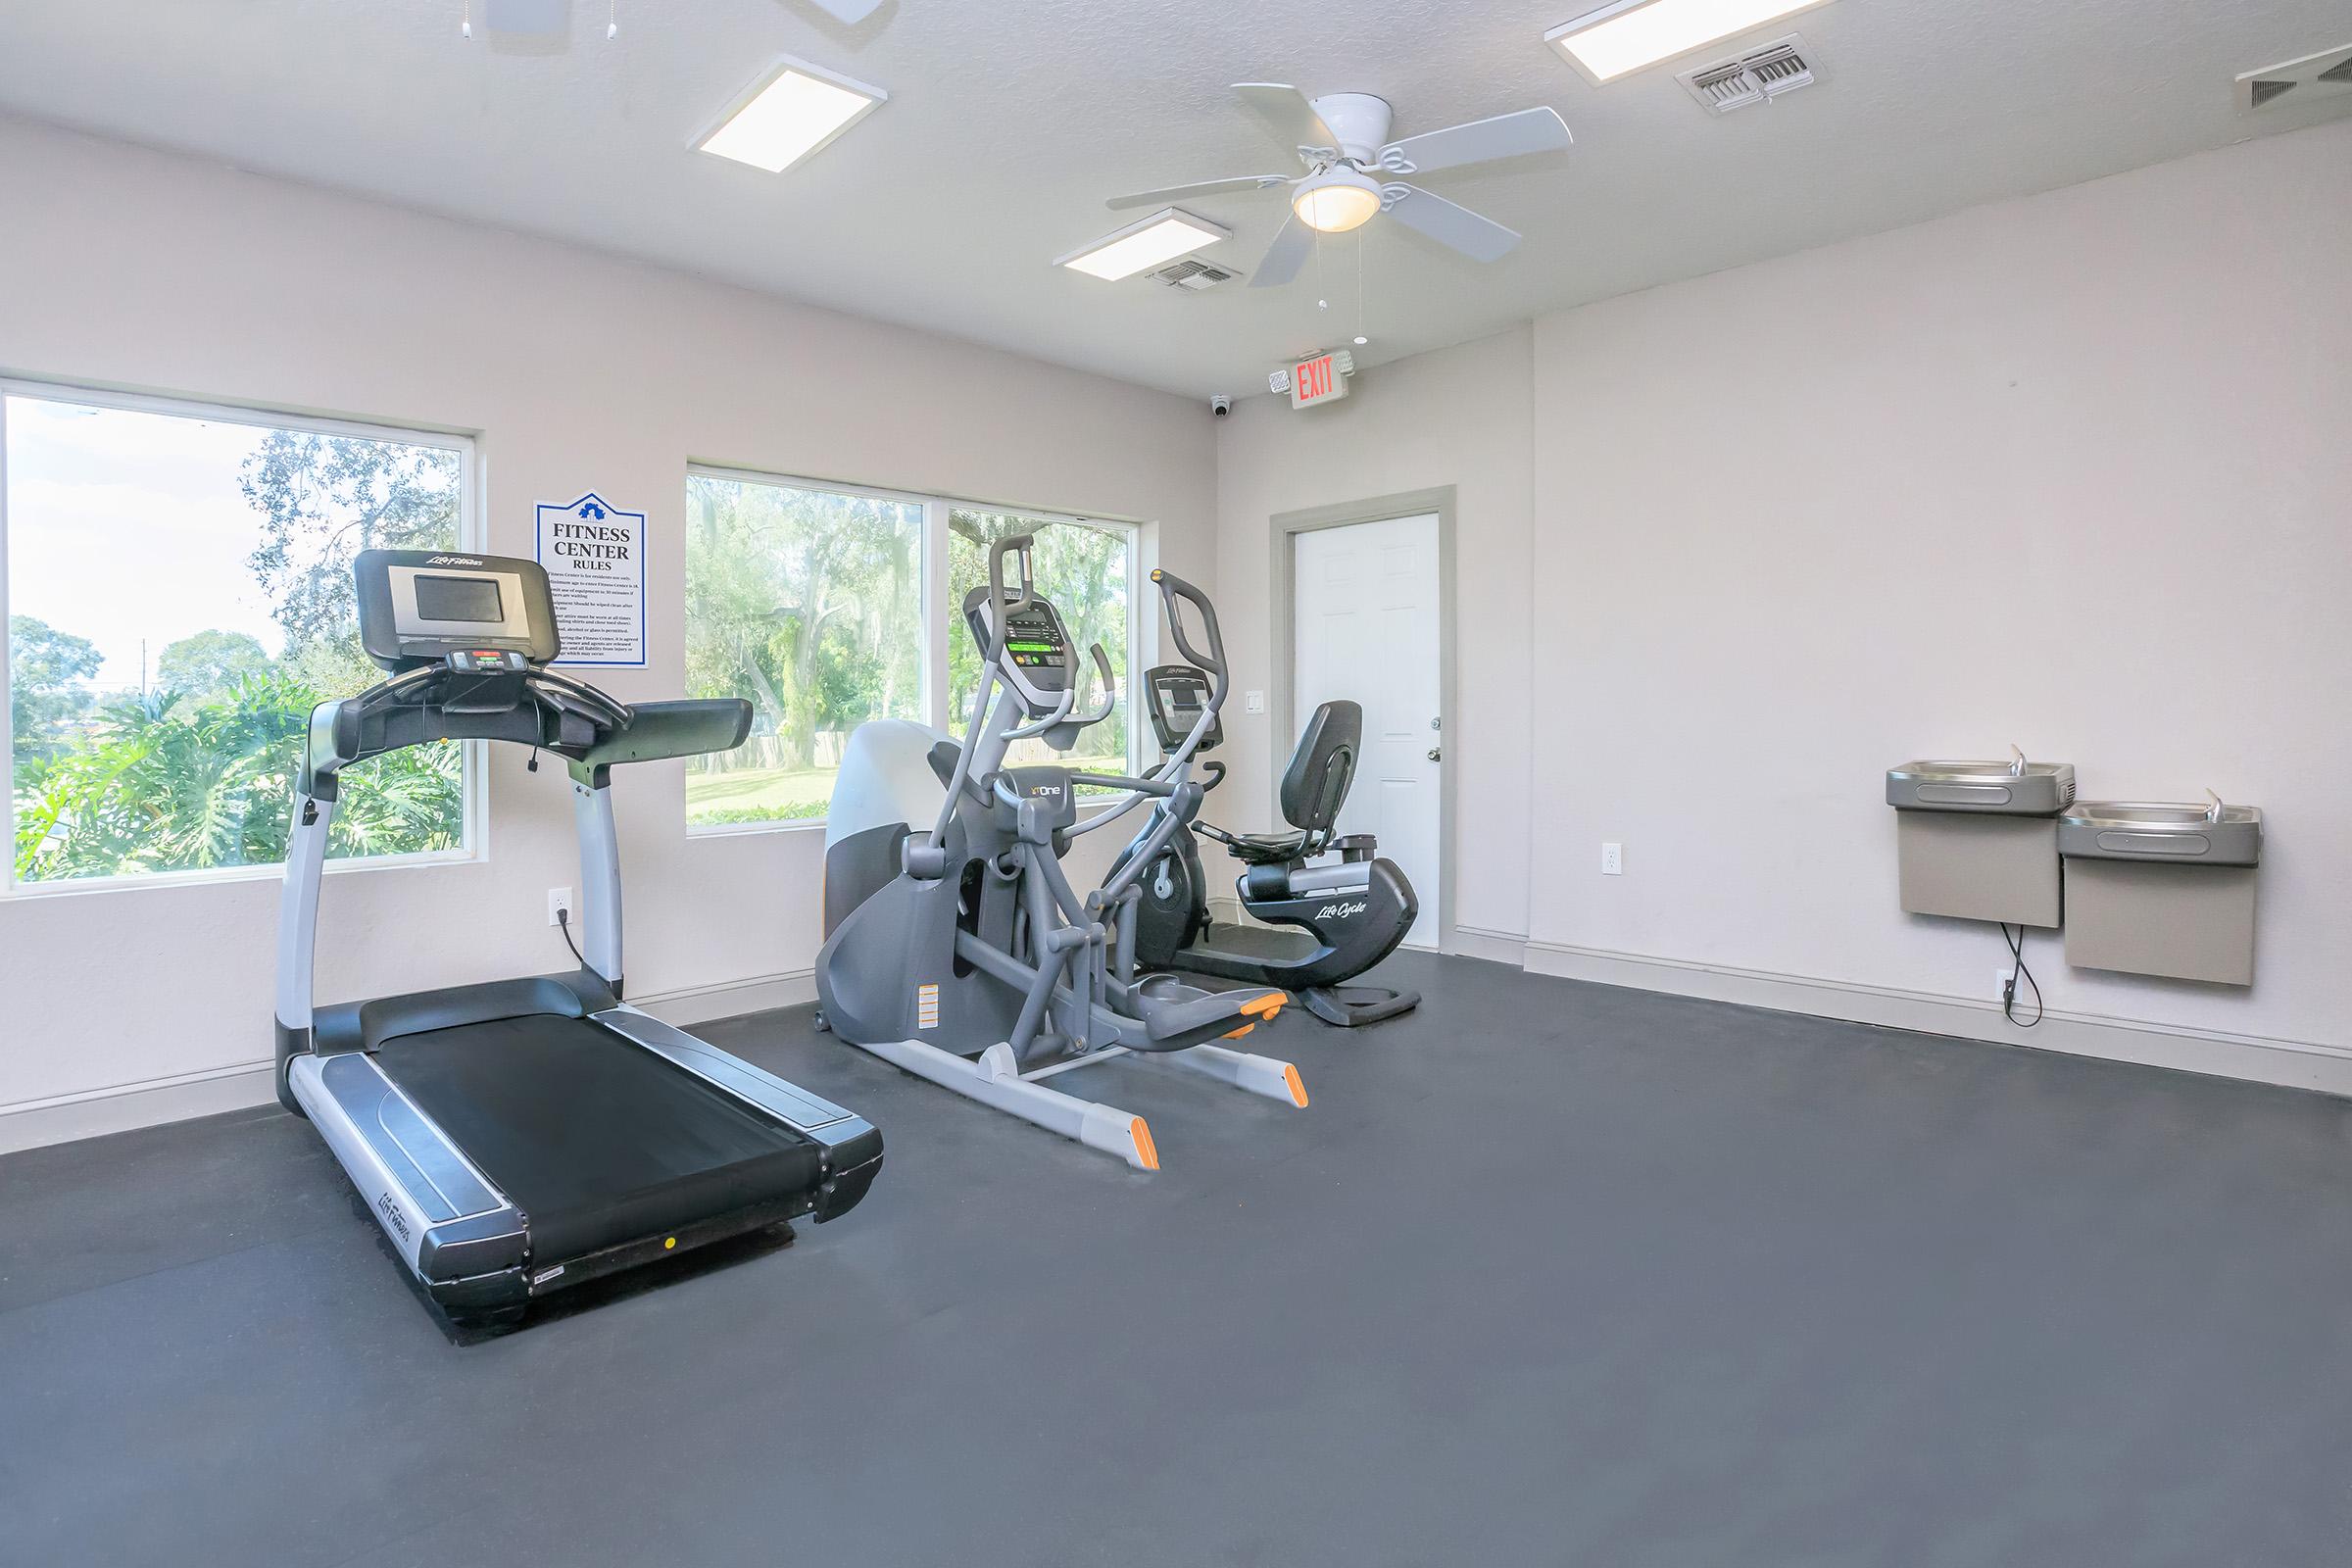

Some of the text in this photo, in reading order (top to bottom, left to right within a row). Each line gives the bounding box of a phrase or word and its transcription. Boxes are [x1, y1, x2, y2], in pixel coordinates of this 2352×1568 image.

[1297, 357, 1333, 400] EXIT
[554, 522, 630, 542] FITNESS
[554, 541, 629, 560] CENTER
[573, 559, 612, 570] RULES
[1314, 902, 1367, 920] Life Cycle
